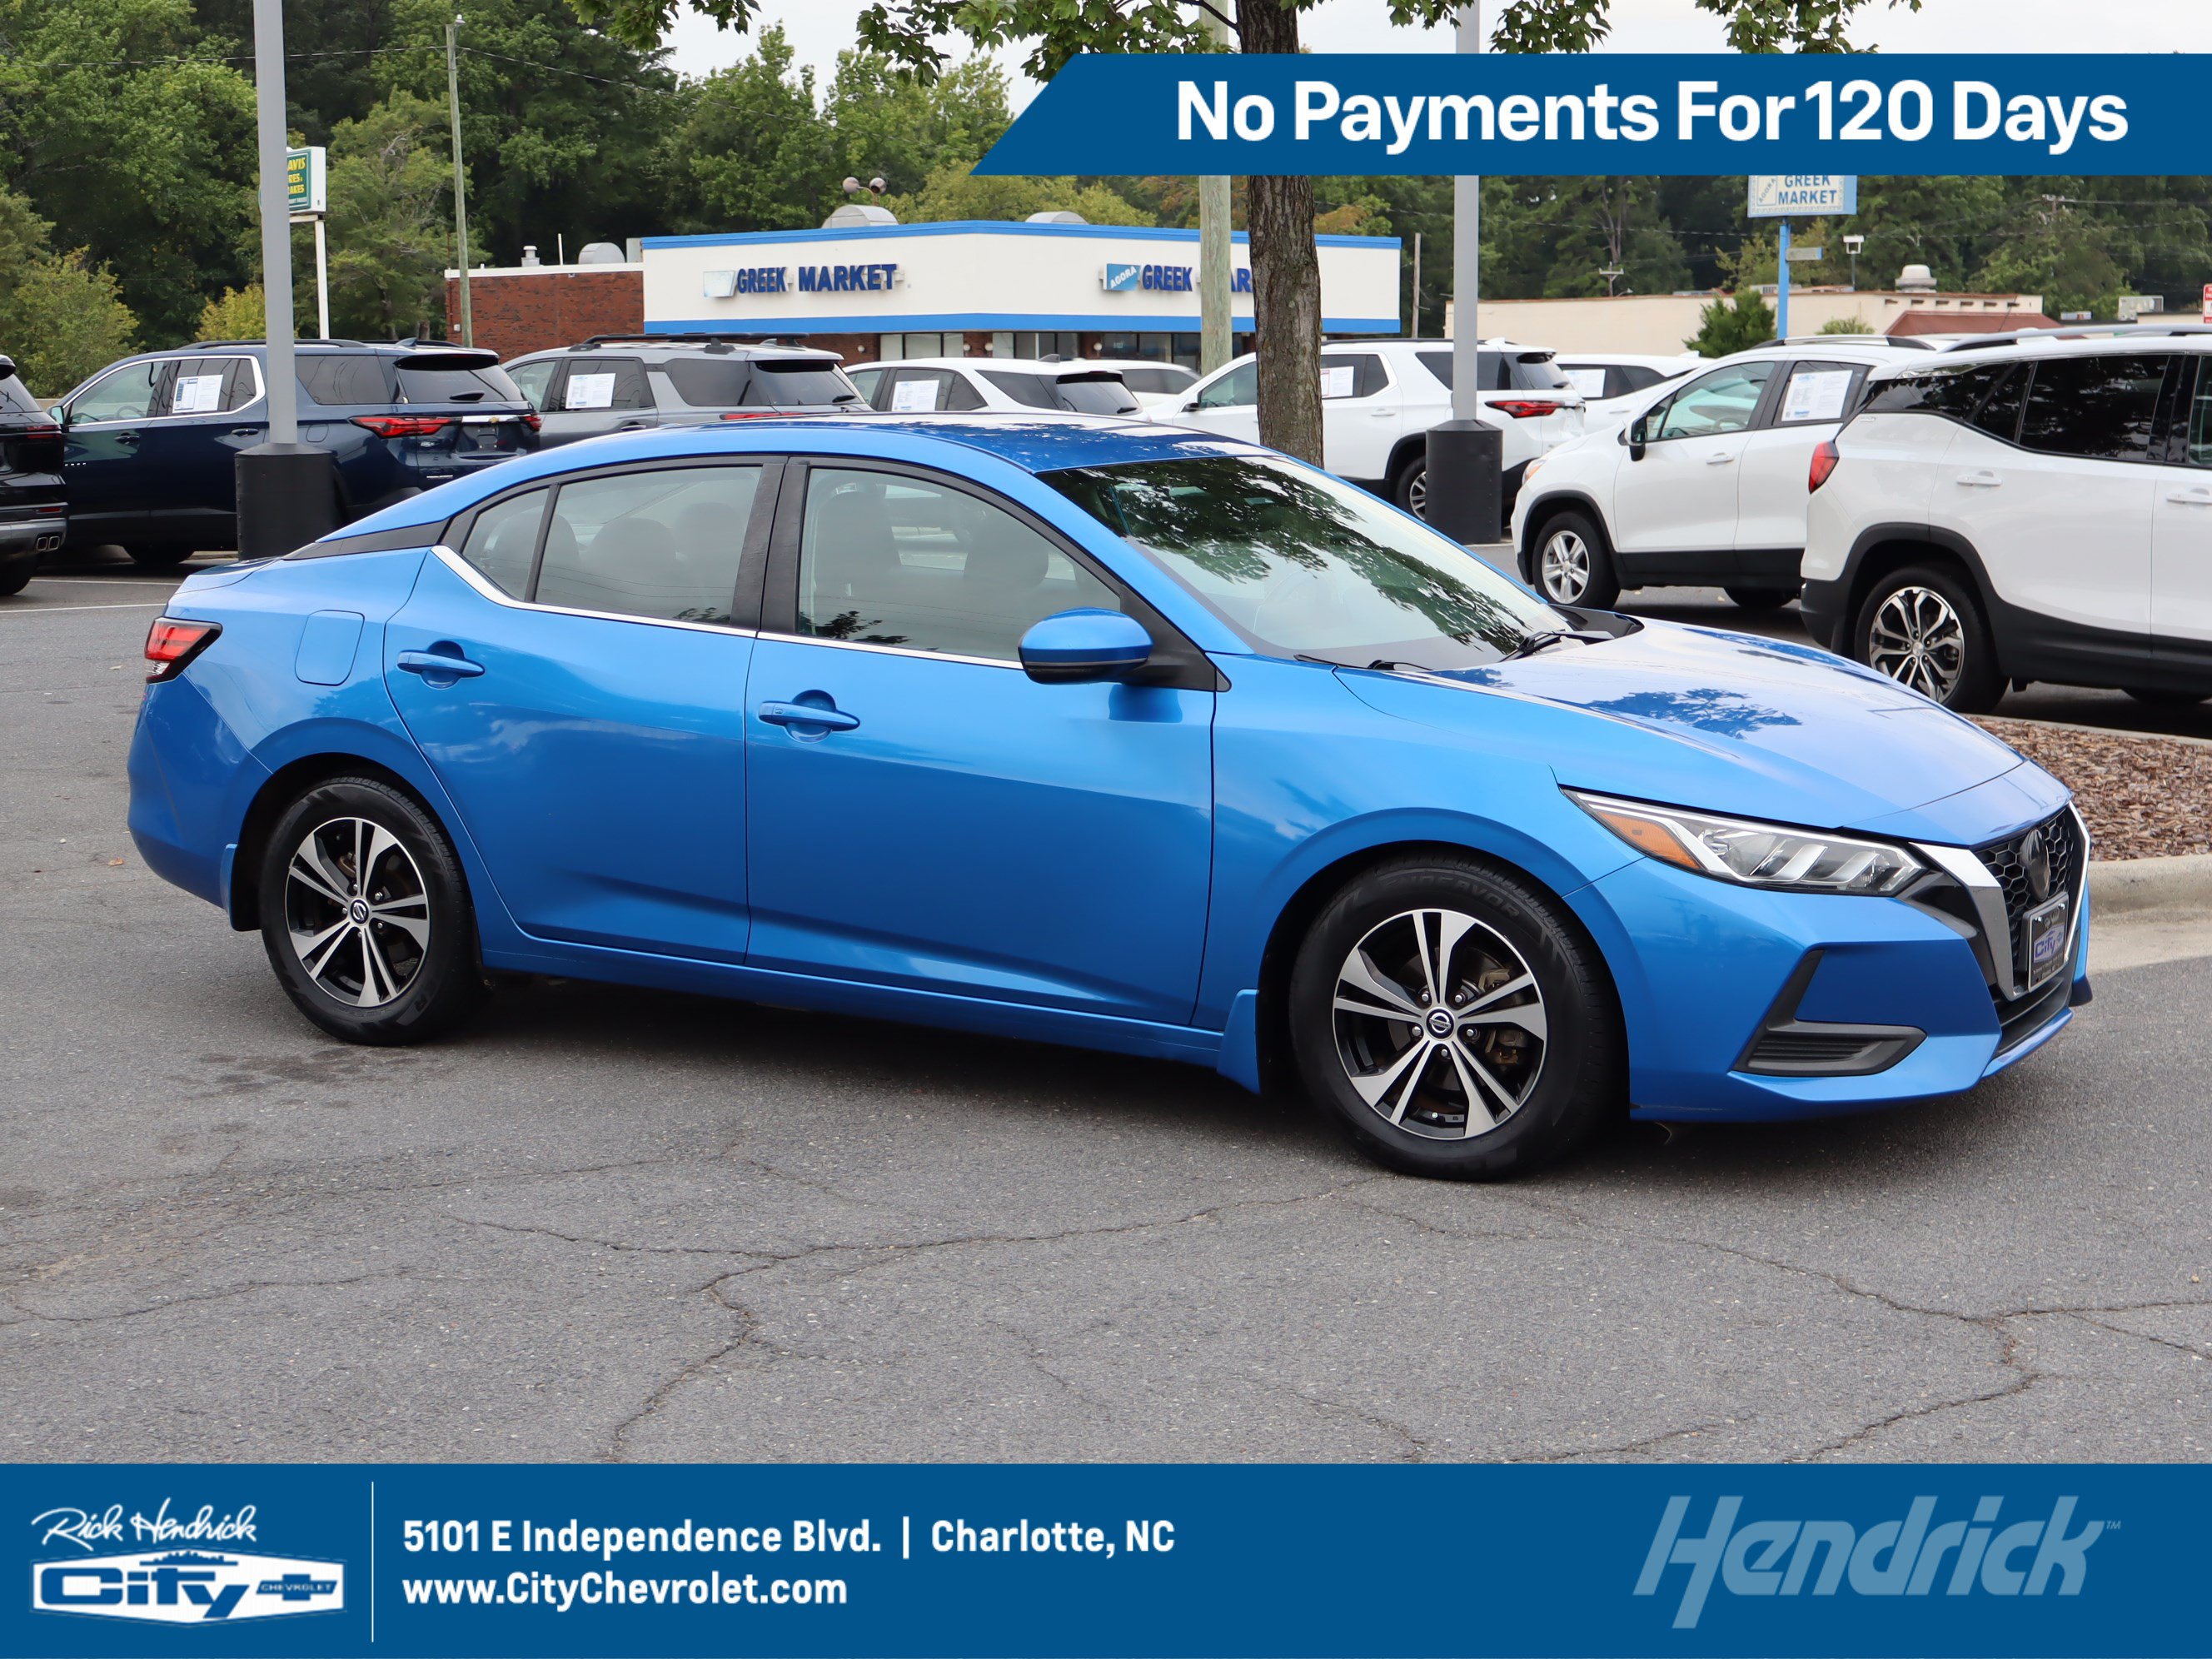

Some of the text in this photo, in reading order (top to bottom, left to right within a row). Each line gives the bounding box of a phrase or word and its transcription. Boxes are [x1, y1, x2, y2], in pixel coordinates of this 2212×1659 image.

[287, 157, 306, 171] AVIS
[288, 173, 300, 183] RES
[1784, 175, 1831, 188] GREEK
[287, 184, 305, 194] AKES
[1778, 190, 1837, 206] MARKET
[737, 263, 898, 294] GREEK MARKET
[1110, 266, 1137, 289] AGORA
[1142, 264, 1193, 291] GREEK
